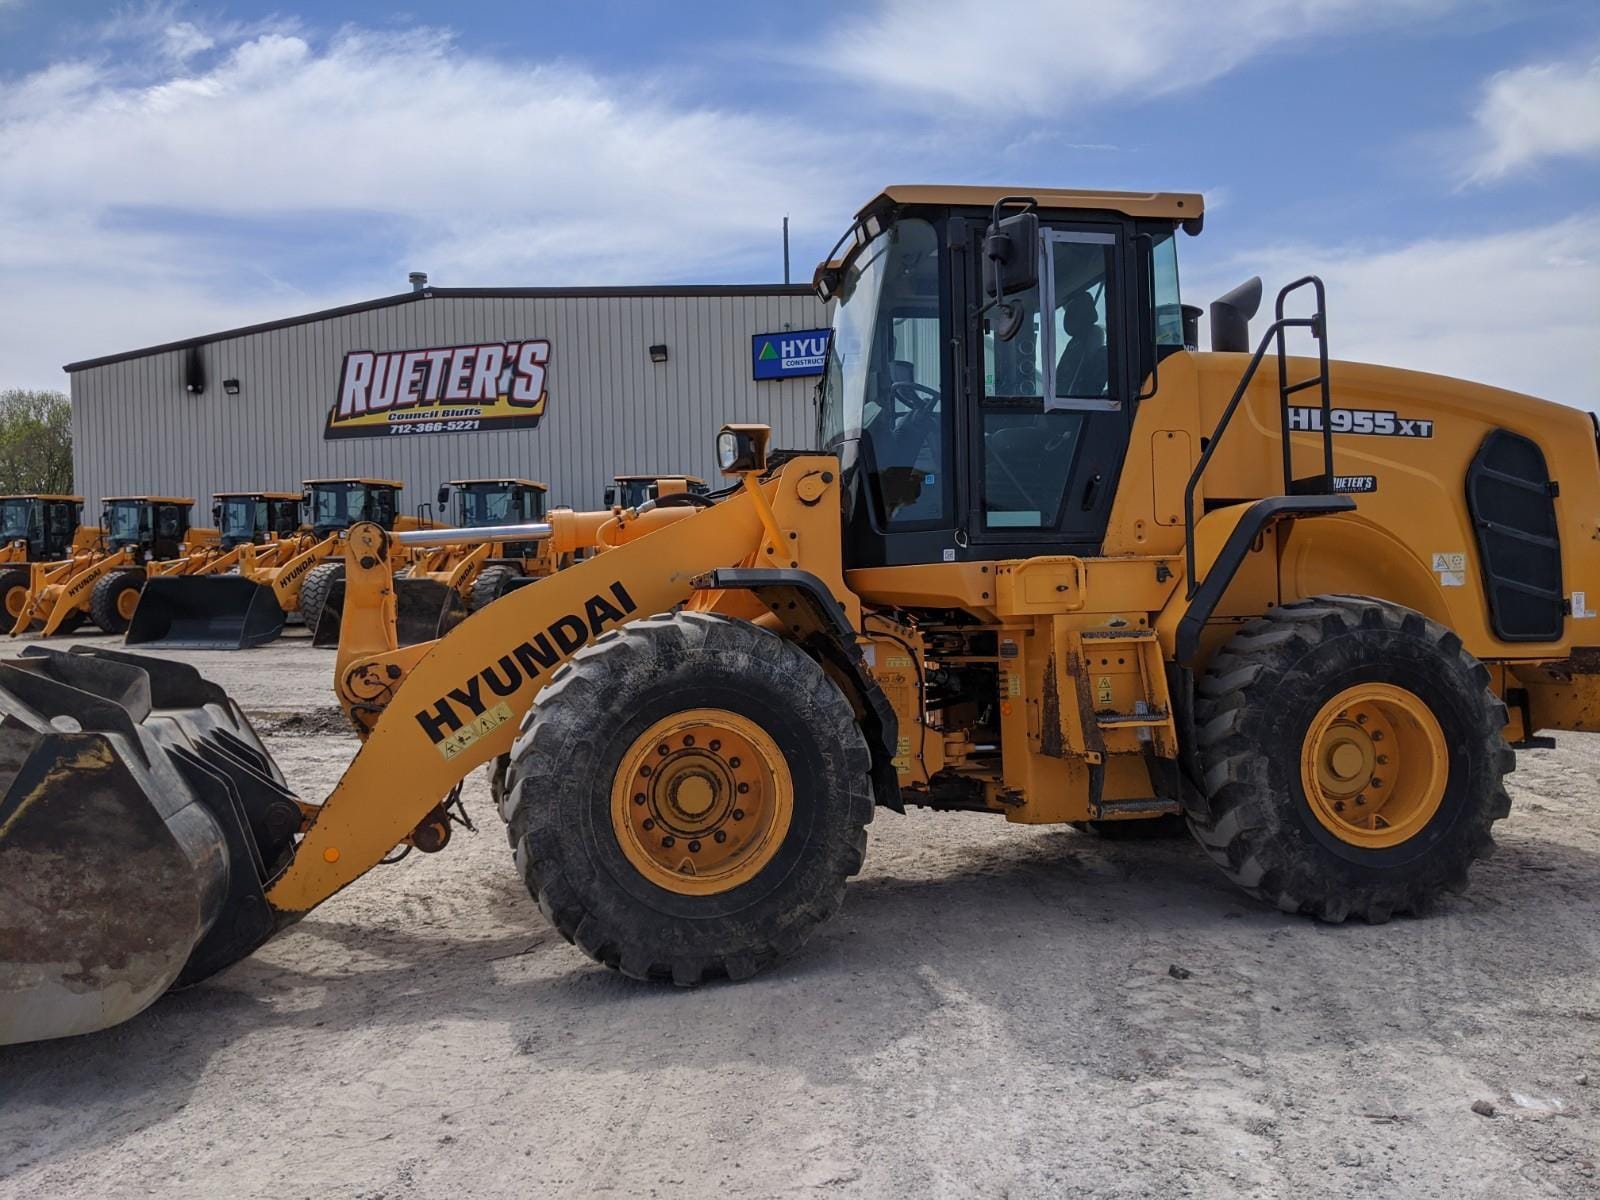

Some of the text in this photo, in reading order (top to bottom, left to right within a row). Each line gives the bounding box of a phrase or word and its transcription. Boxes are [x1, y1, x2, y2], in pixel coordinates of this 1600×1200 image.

[781, 337, 829, 358] HYU
[339, 342, 549, 416] RUETER'S
[388, 408, 481, 421] Council Bluffs
[389, 420, 480, 434] 712-366-5221
[1333, 476, 1373, 489] UETER'S
[68, 568, 101, 597] HYUNDAI
[280, 554, 316, 589] HYUNDAI
[454, 560, 476, 590] YUNDAI
[415, 580, 638, 745] HYUNDAI
